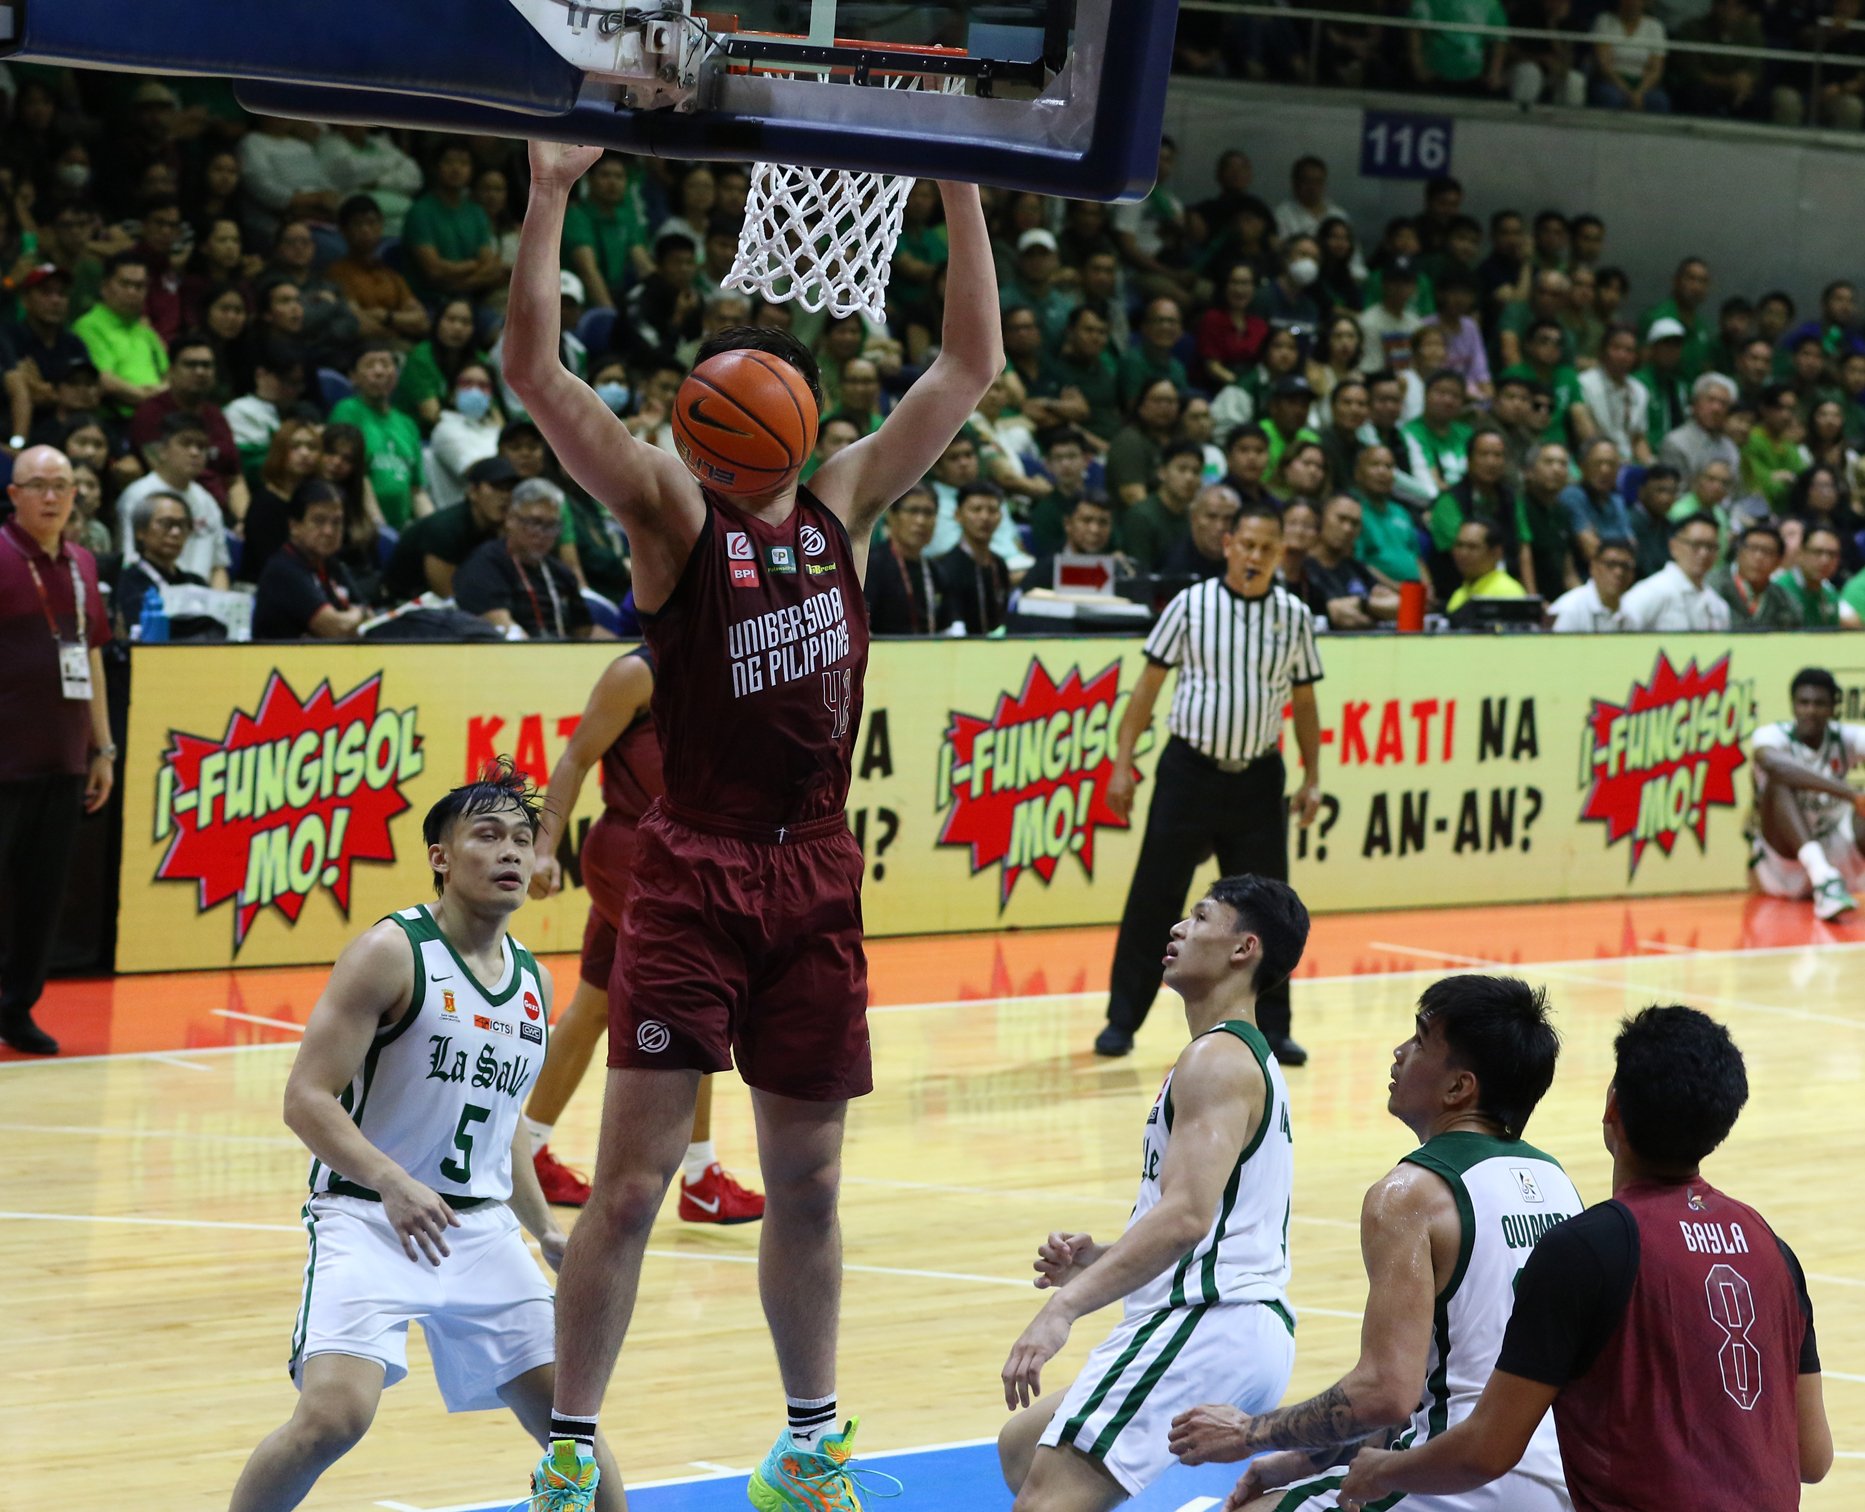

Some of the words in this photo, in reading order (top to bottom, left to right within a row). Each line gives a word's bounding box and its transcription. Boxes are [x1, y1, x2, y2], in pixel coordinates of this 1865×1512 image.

[1367, 122, 1446, 169] 116
[734, 569, 755, 579] BPI
[728, 586, 844, 660] UNIBERSIDA
[732, 655, 764, 699] NG
[768, 619, 850, 687] PILIPINAS
[936, 690, 1156, 814] I-FUNGIS
[1478, 695, 1539, 763] NA
[1579, 678, 1757, 791] I-FUNGISOL
[154, 706, 424, 841] I-FUNGISOL
[1634, 759, 1710, 841] MO!
[243, 806, 351, 908] MO!
[1005, 778, 1096, 870] MO!
[1362, 786, 1544, 858] AN-AN?
[426, 1034, 468, 1084] La
[471, 1043, 530, 1098] Sall
[490, 1020, 513, 1035] ICTSI
[440, 1103, 491, 1184] 5
[1679, 1220, 1749, 1255] BAYLA
[1705, 1263, 1761, 1411] 8
